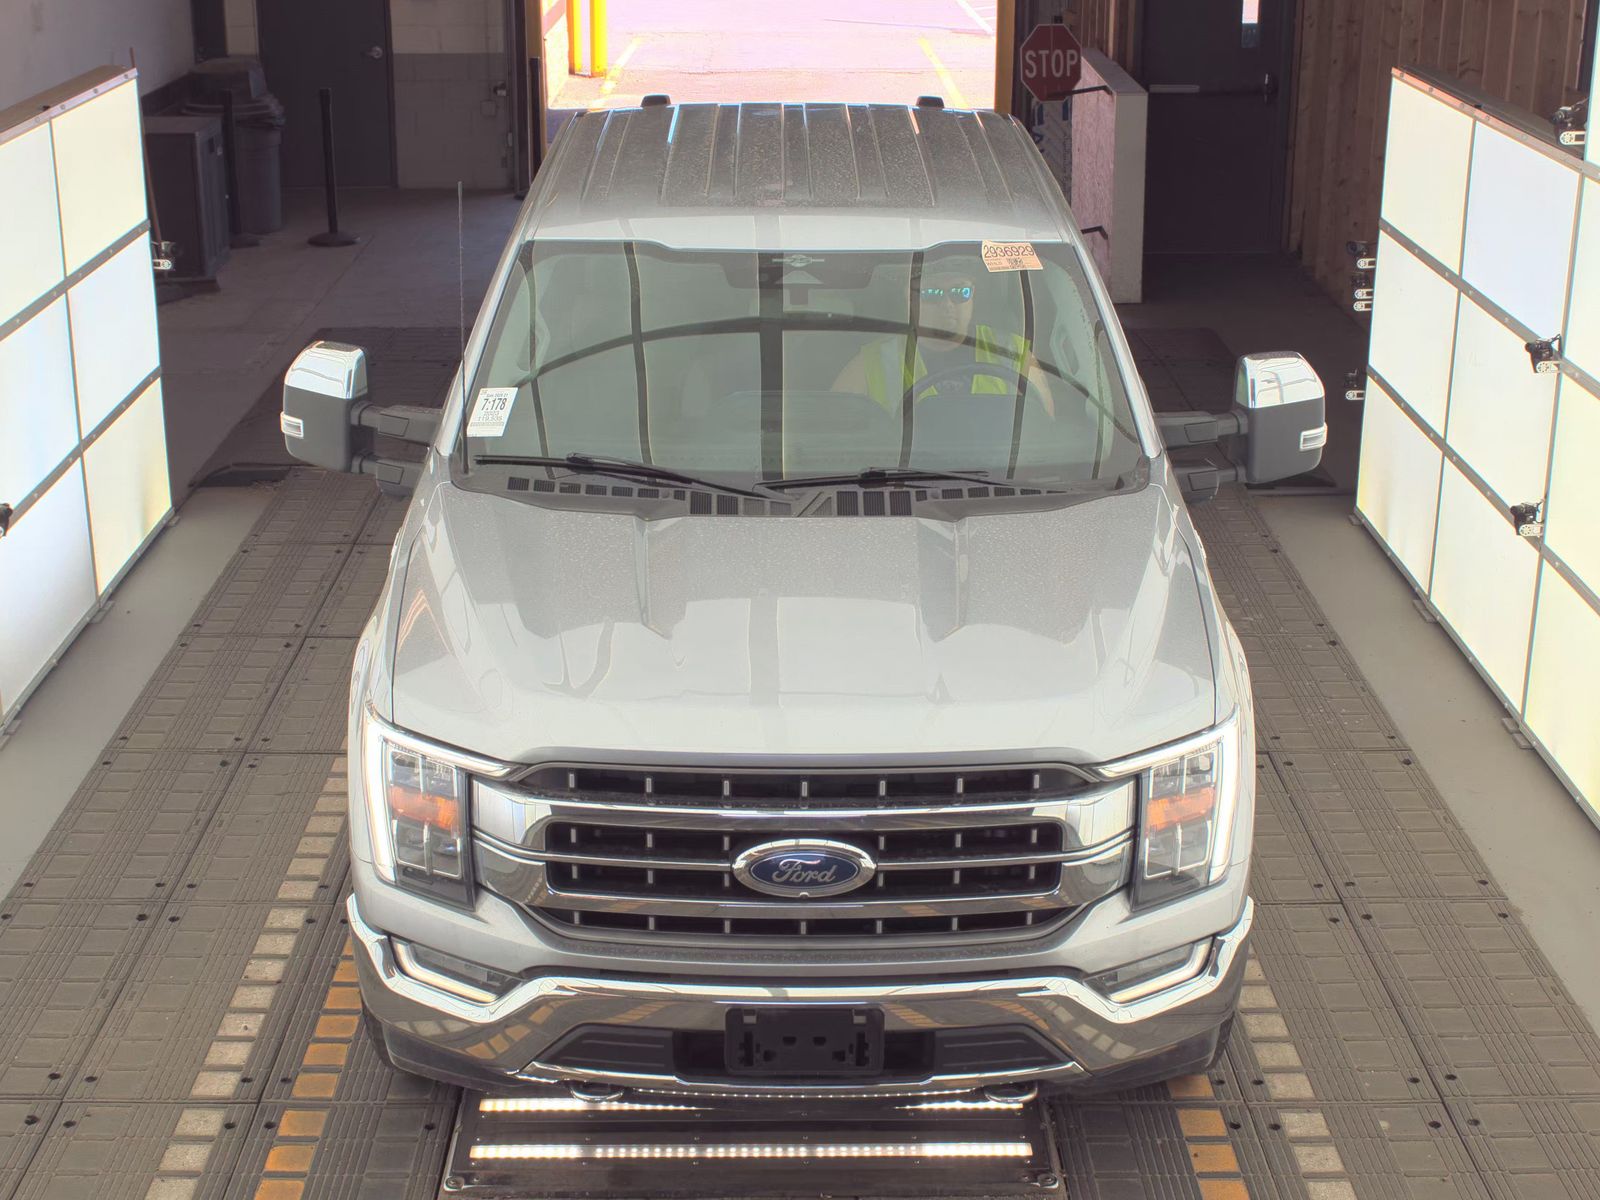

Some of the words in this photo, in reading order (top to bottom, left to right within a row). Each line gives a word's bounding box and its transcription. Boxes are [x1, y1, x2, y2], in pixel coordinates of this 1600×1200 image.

[1025, 49, 1078, 78] STOP
[984, 245, 1034, 258] 2936929
[481, 398, 507, 411] 7:178
[772, 858, 838, 883] Ford
